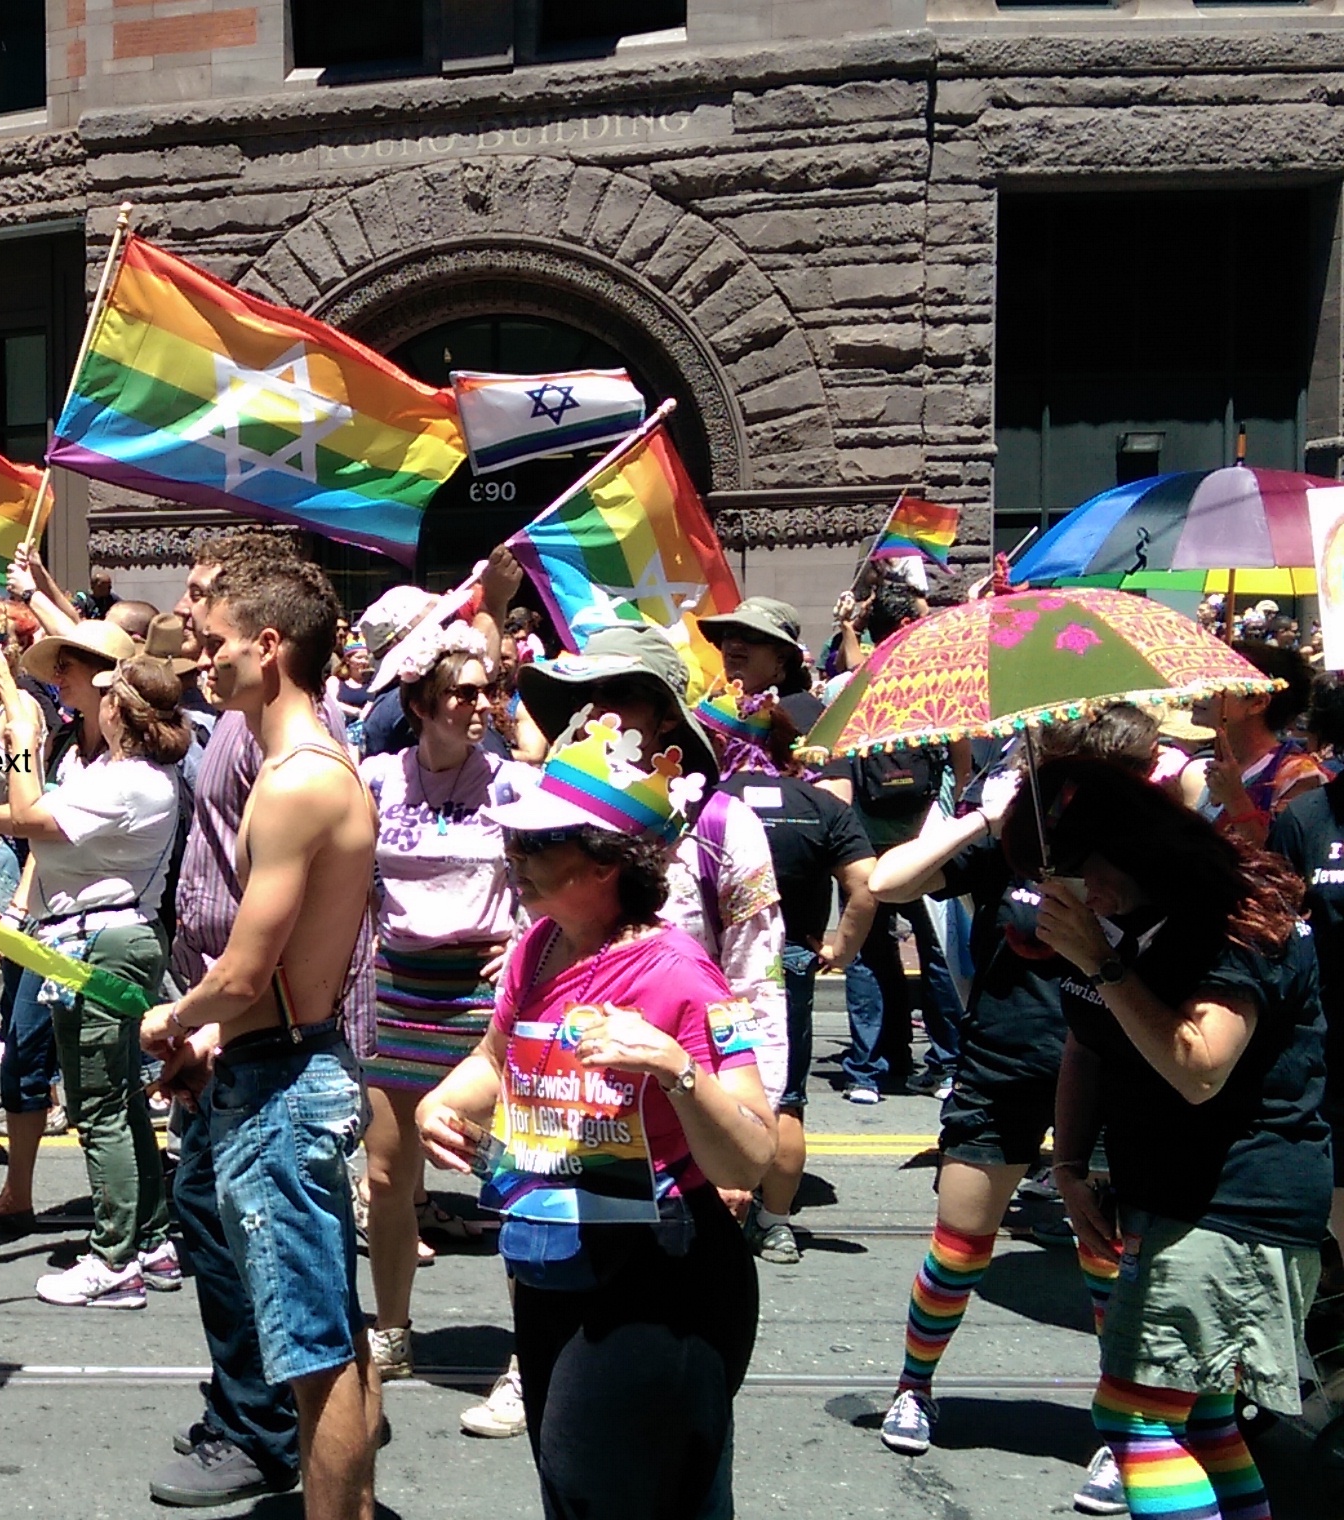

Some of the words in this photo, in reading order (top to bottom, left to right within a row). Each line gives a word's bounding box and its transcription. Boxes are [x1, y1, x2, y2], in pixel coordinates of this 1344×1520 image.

[476, 109, 690, 149] BUILDING
[469, 481, 517, 502] 690
[380, 826, 422, 852] ay
[584, 1071, 635, 1106] Voice
[511, 1103, 530, 1133] for
[532, 1105, 565, 1138] LGBT
[567, 1109, 631, 1148] Rights
